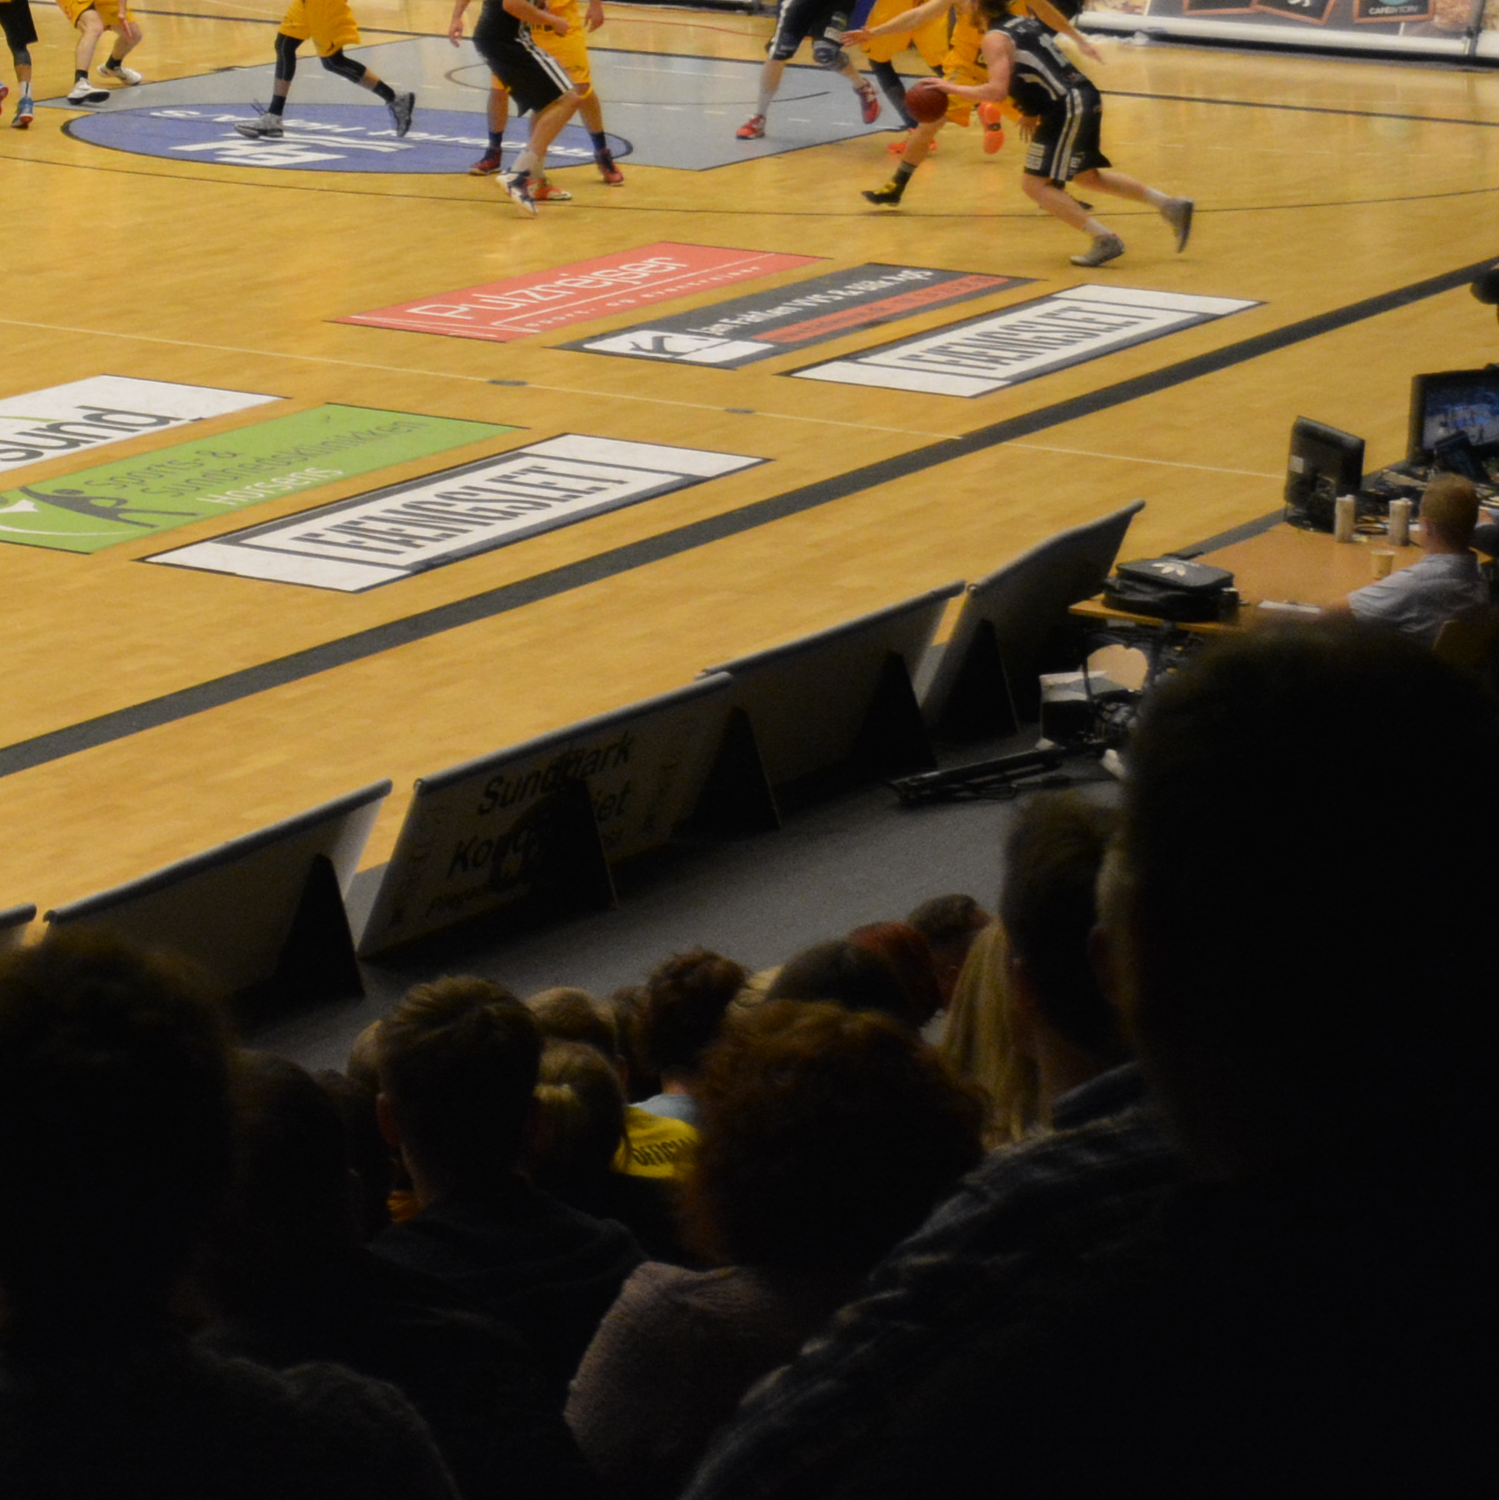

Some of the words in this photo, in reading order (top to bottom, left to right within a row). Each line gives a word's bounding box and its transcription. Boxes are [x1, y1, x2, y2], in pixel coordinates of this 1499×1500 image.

[406, 256, 690, 320] Pulzrejser
[196, 466, 344, 506] Horsens
[289, 464, 630, 556] FÆNGSLET
